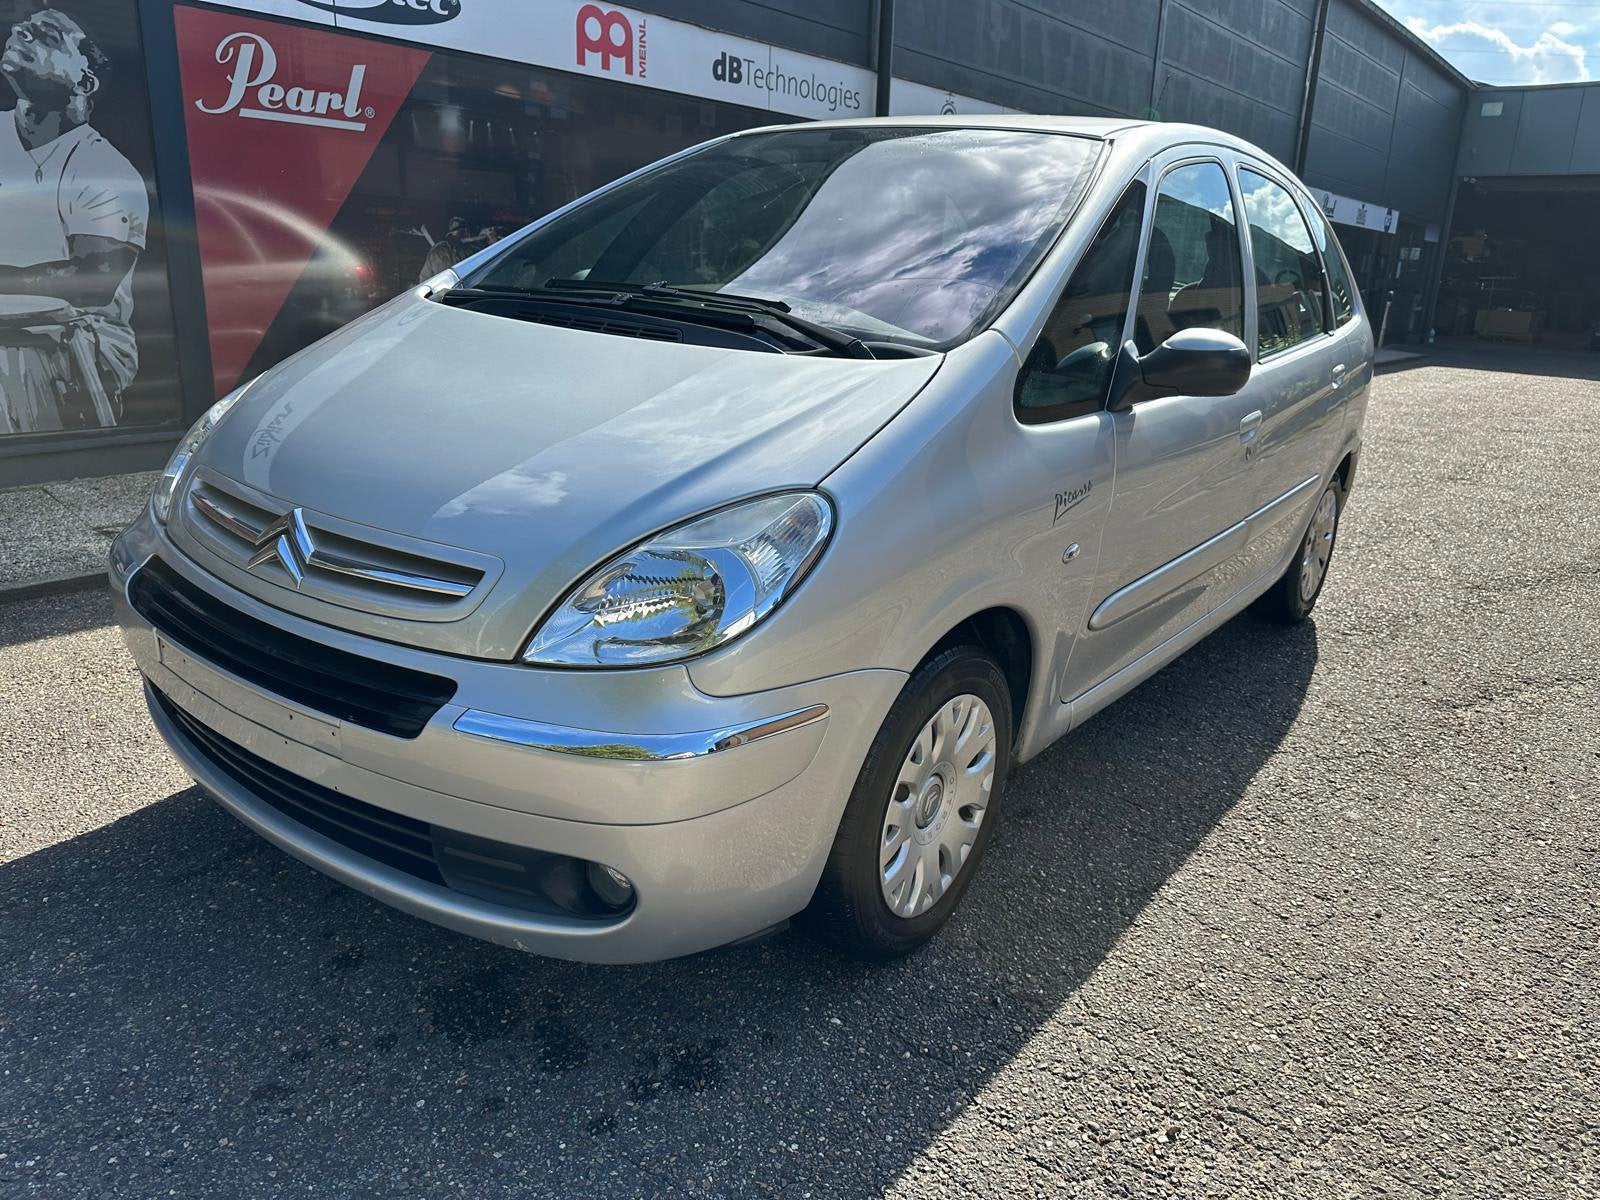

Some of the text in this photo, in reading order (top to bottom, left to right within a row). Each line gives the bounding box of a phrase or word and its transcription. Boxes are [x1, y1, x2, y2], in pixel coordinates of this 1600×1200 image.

[195, 32, 366, 118] Pearl
[712, 52, 861, 111] dBTechnologies
[1053, 480, 1093, 526] Picasso
